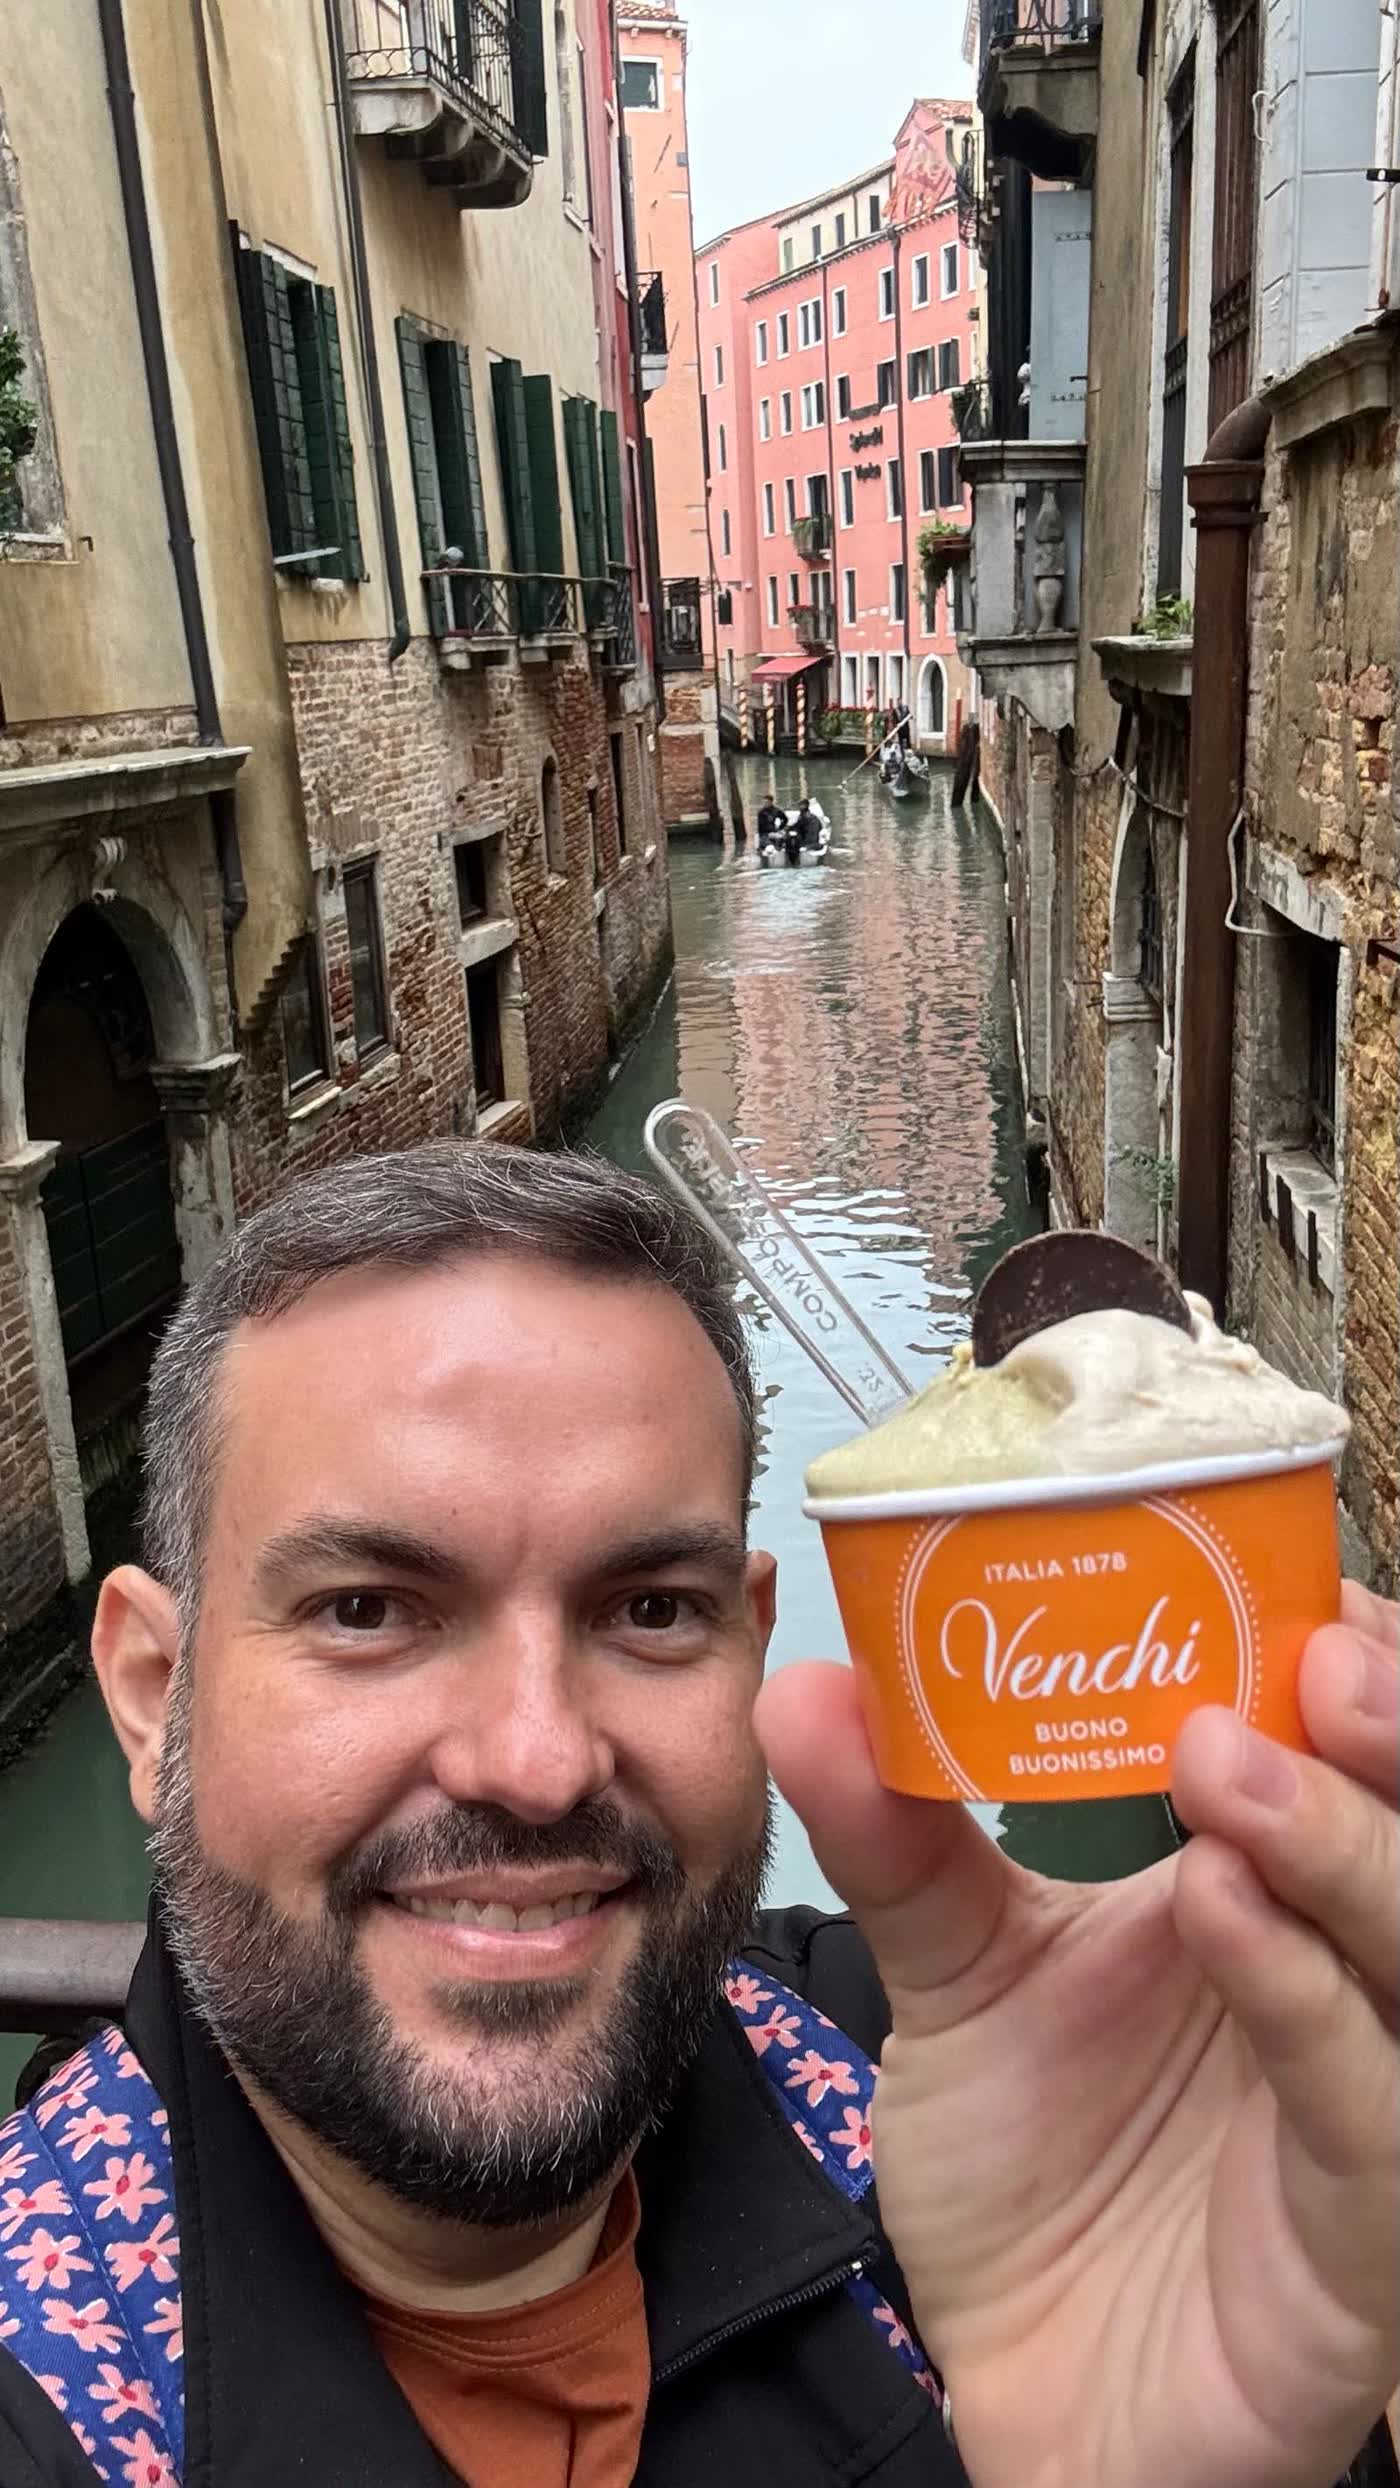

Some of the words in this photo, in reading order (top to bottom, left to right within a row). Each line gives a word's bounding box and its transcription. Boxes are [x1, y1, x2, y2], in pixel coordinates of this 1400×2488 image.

[984, 1559, 1064, 1584] ITALIA
[1072, 1551, 1128, 1576] 1878
[940, 1595, 1201, 1702] Venchi
[1034, 1716, 1128, 1743] BUONO
[1009, 1743, 1166, 1775] BUONISSIMO
